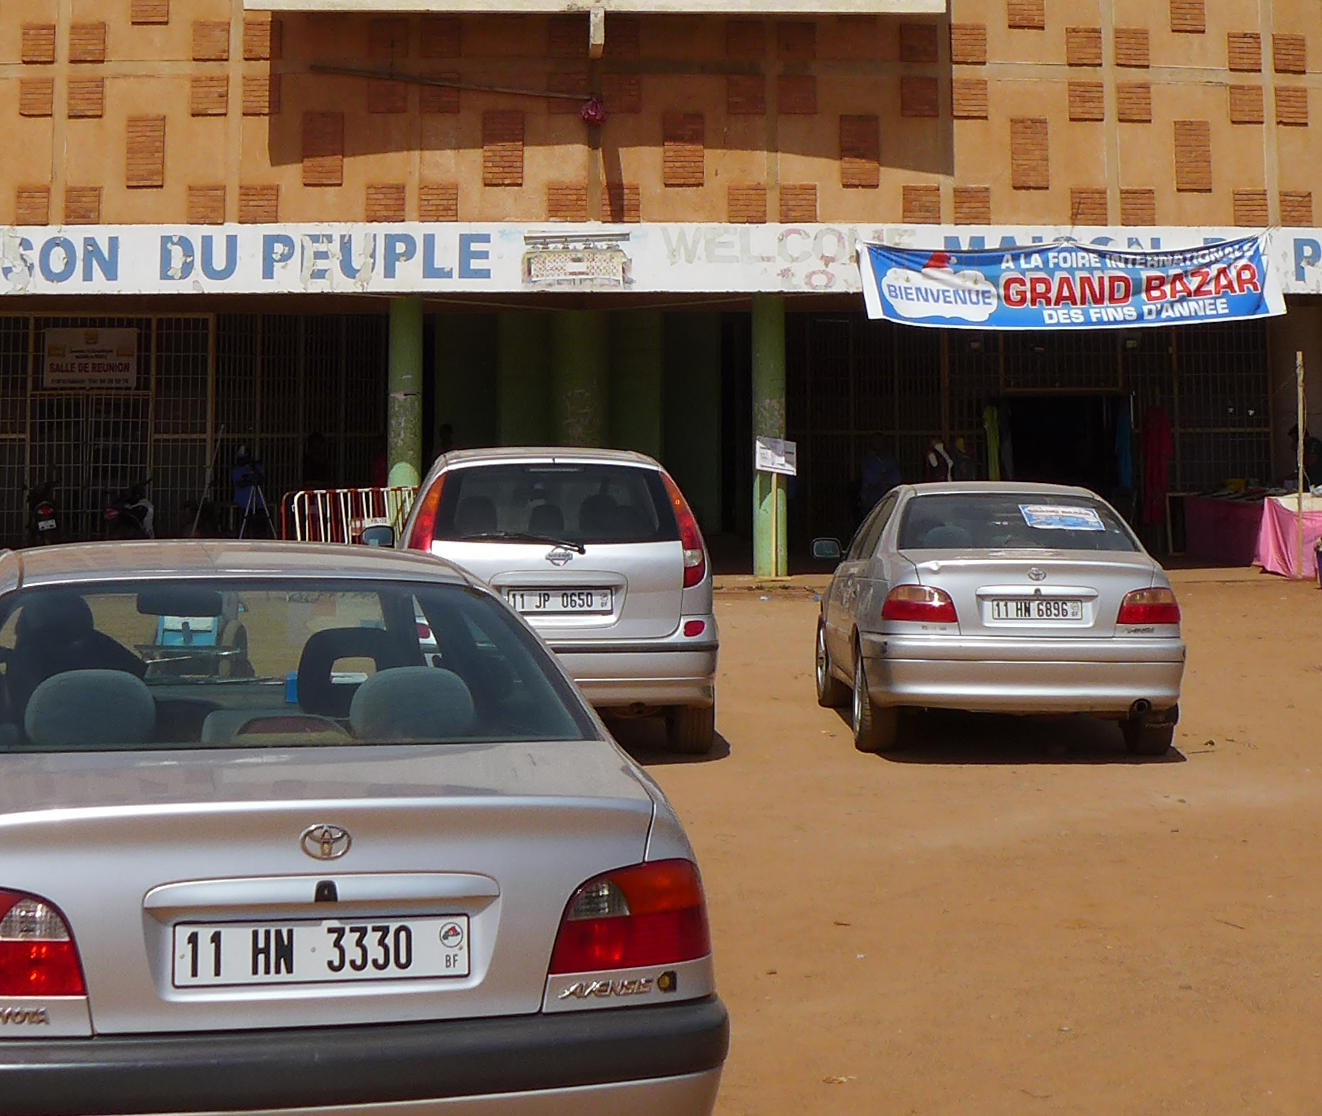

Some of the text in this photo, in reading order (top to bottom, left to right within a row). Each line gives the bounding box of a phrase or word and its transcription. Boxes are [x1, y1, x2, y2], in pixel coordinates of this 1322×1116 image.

[159, 234, 238, 281] DU
[263, 233, 492, 280] PEUPLE
[1019, 252, 1044, 270] LA
[1048, 251, 1100, 270] FOIRE
[1002, 261, 1261, 308] GRAND BAZAR
[886, 283, 993, 306] BIENVENUE
[1043, 308, 1085, 324] DES
[1088, 306, 1137, 323] FINS
[49, 362, 76, 373] SALLE
[78, 362, 90, 373] DE
[511, 592, 594, 610] 11 JP 0650
[995, 601, 1068, 618] 11 HN 6896
[187, 924, 413, 978] 11 HN 3330
[445, 953, 459, 969] BF
